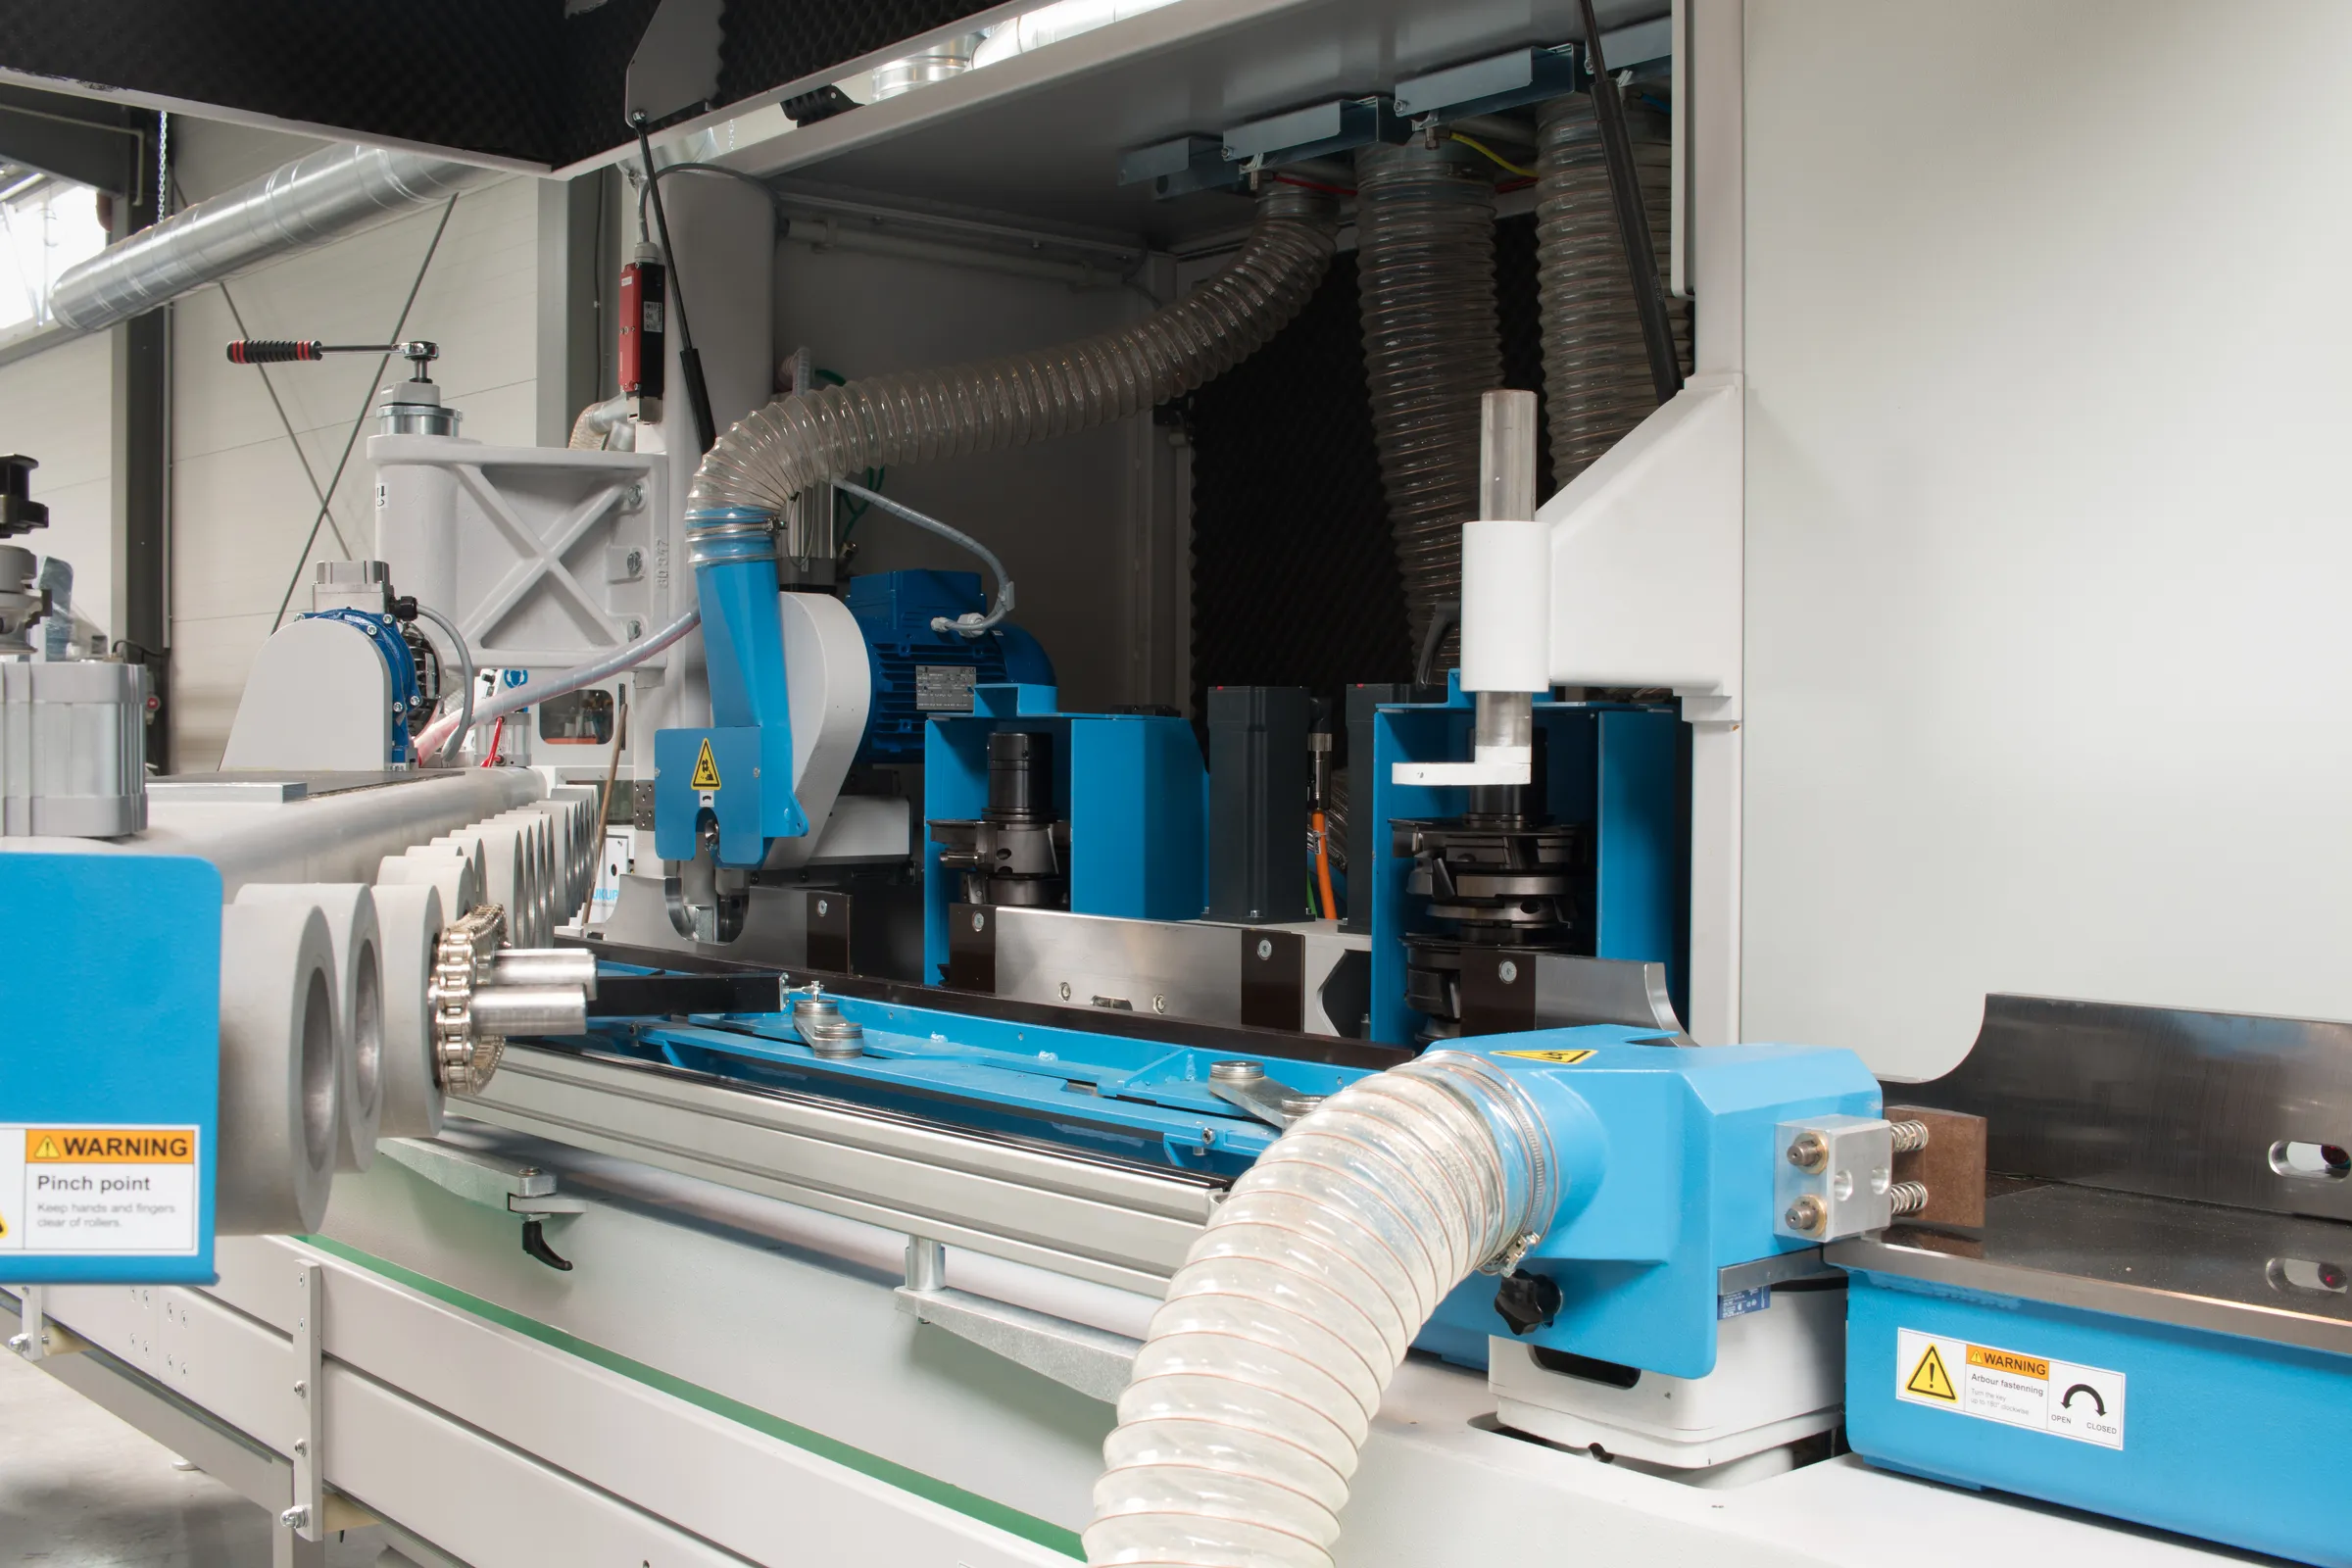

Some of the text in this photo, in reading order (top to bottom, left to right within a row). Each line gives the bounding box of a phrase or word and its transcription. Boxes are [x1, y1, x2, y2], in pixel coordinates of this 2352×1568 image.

[63, 1137, 188, 1156] WARNING
[36, 1175, 151, 1195] Pinch point
[37, 1203, 175, 1215] Keep hands and fingers
[37, 1218, 66, 1227] clear
[70, 1217, 81, 1227] of
[1984, 1352, 2046, 1376] WARNING
[1971, 1373, 2044, 1397] Arbour fastenning
[1971, 1388, 2007, 1402] Turn the key
[2000, 1403, 2030, 1415] clockwise
[2051, 1414, 2072, 1424] OPEN
[2086, 1422, 2117, 1434] CLOSED
